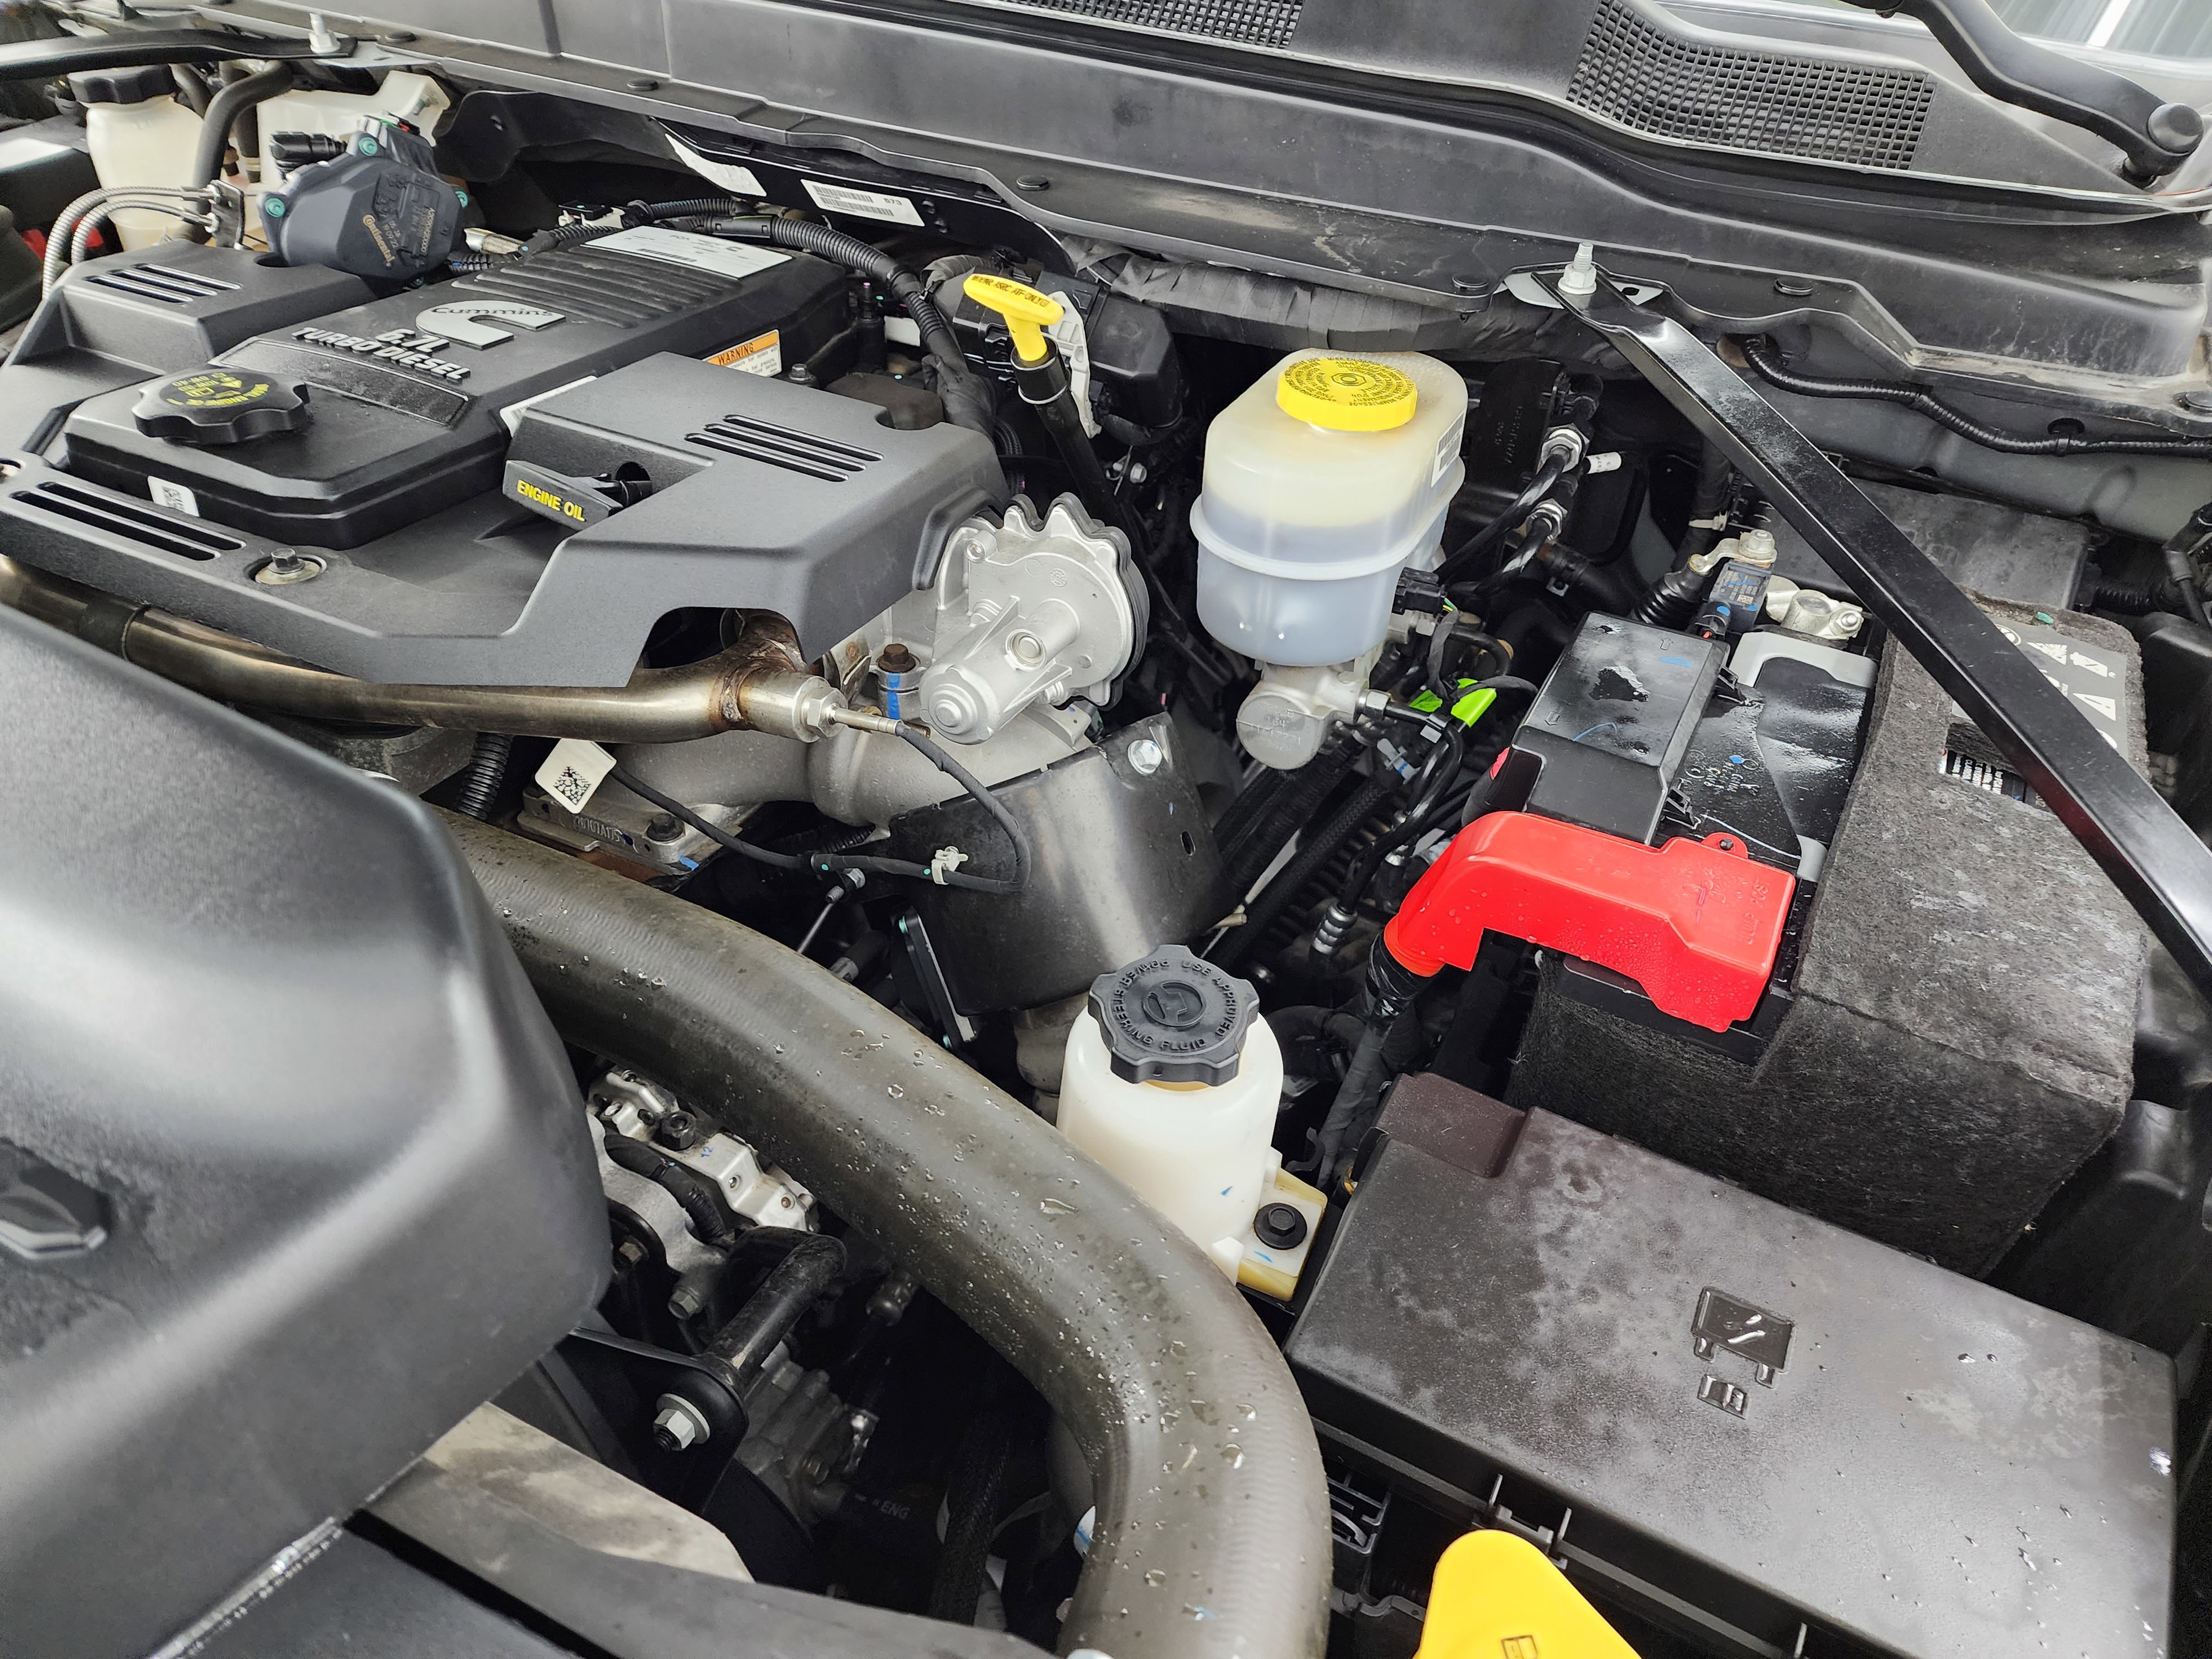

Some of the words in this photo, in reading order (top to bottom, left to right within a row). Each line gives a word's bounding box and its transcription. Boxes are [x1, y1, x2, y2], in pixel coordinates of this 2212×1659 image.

[363, 214, 396, 263] Continental
[1011, 288, 1027, 296] ATF
[1024, 292, 1043, 305] ONLY
[431, 306, 555, 317] Cummins
[375, 328, 450, 354] 6.7L
[717, 342, 754, 366] WARNING
[291, 326, 384, 352] TURBO
[373, 345, 471, 383] DIESEL
[517, 479, 562, 512] ENGINE
[564, 501, 585, 522] OIL
[1993, 777, 2004, 788] FCA
[1119, 959, 1170, 987] POWER
[1182, 959, 1212, 977] USE
[1113, 988, 1155, 1046] STEERING
[1212, 977, 1238, 1038] APPROVED
[1160, 1037, 1207, 1051] FLUID
